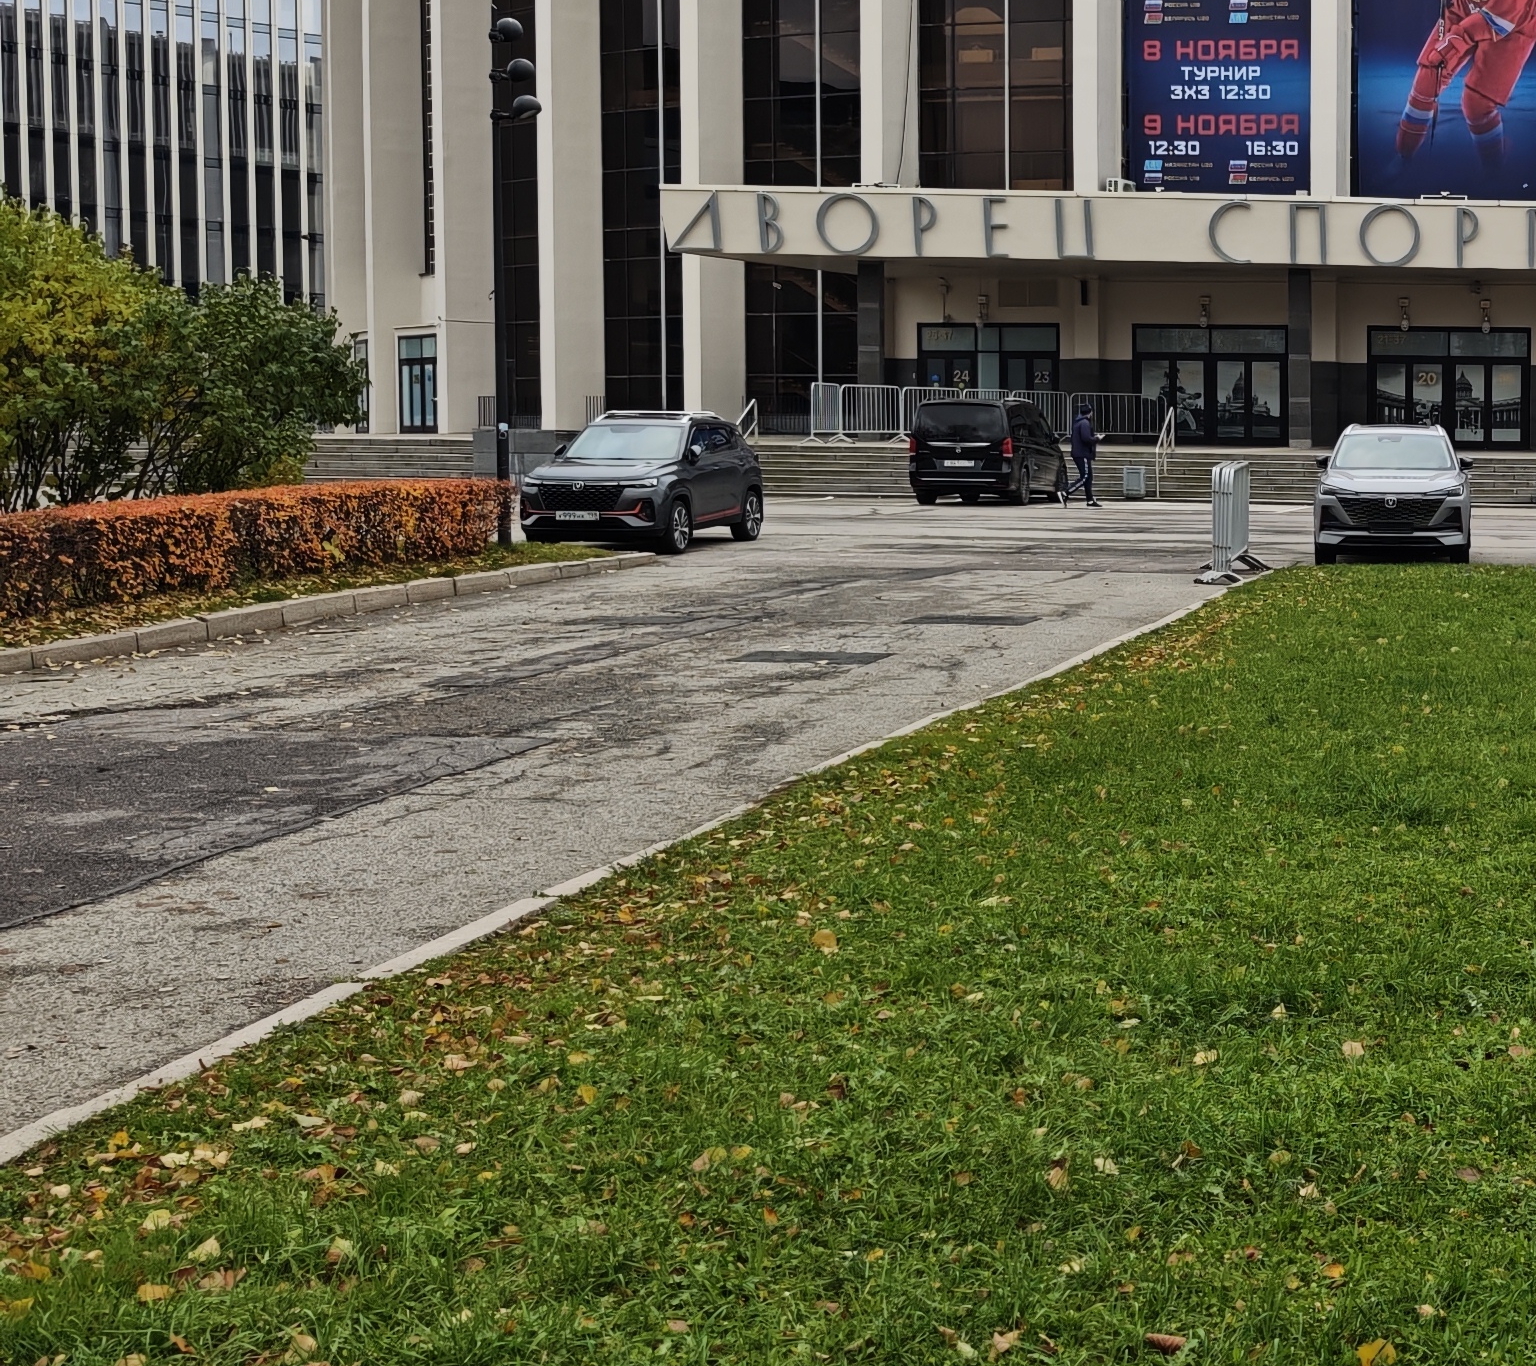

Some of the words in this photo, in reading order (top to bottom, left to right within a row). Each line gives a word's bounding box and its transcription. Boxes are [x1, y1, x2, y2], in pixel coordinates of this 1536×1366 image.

[1143, 40, 1161, 61] 8
[1176, 39, 1299, 61] НОЯБРЯ
[1180, 66, 1261, 81] ТУРНИР
[1219, 85, 1271, 100] 12:30
[1144, 114, 1162, 135] 9
[1176, 114, 1299, 135] НОЯБРЯ
[1148, 141, 1200, 156] 12:30
[1246, 141, 1299, 156] 16:30
[670, 190, 1095, 259] ДВОРЕЦ
[953, 370, 970, 382] 24
[1034, 371, 1050, 383] 23
[1418, 372, 1437, 385] 20
